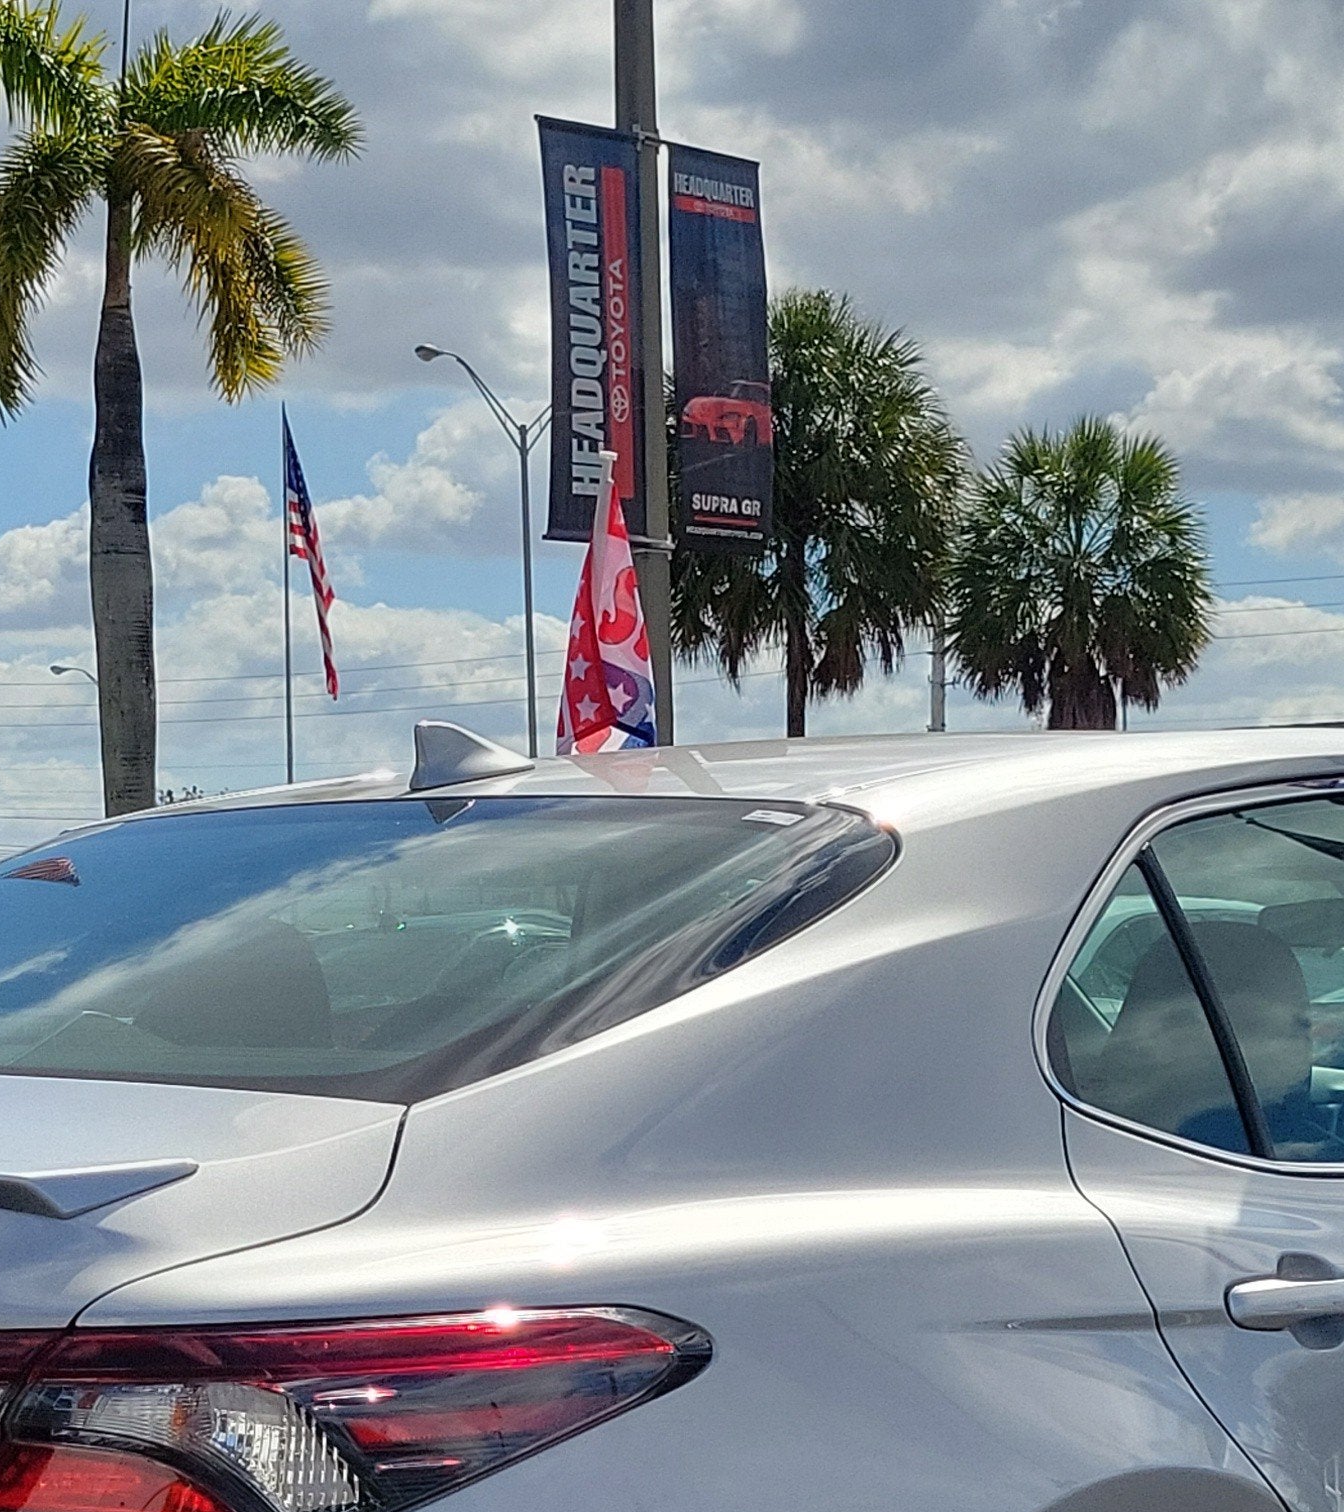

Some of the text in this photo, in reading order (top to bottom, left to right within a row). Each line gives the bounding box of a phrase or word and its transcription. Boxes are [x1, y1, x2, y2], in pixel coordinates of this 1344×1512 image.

[563, 163, 605, 497] HEADQUARTER
[608, 257, 628, 381] TOYOTA
[692, 493, 761, 517] SUPRA GR
